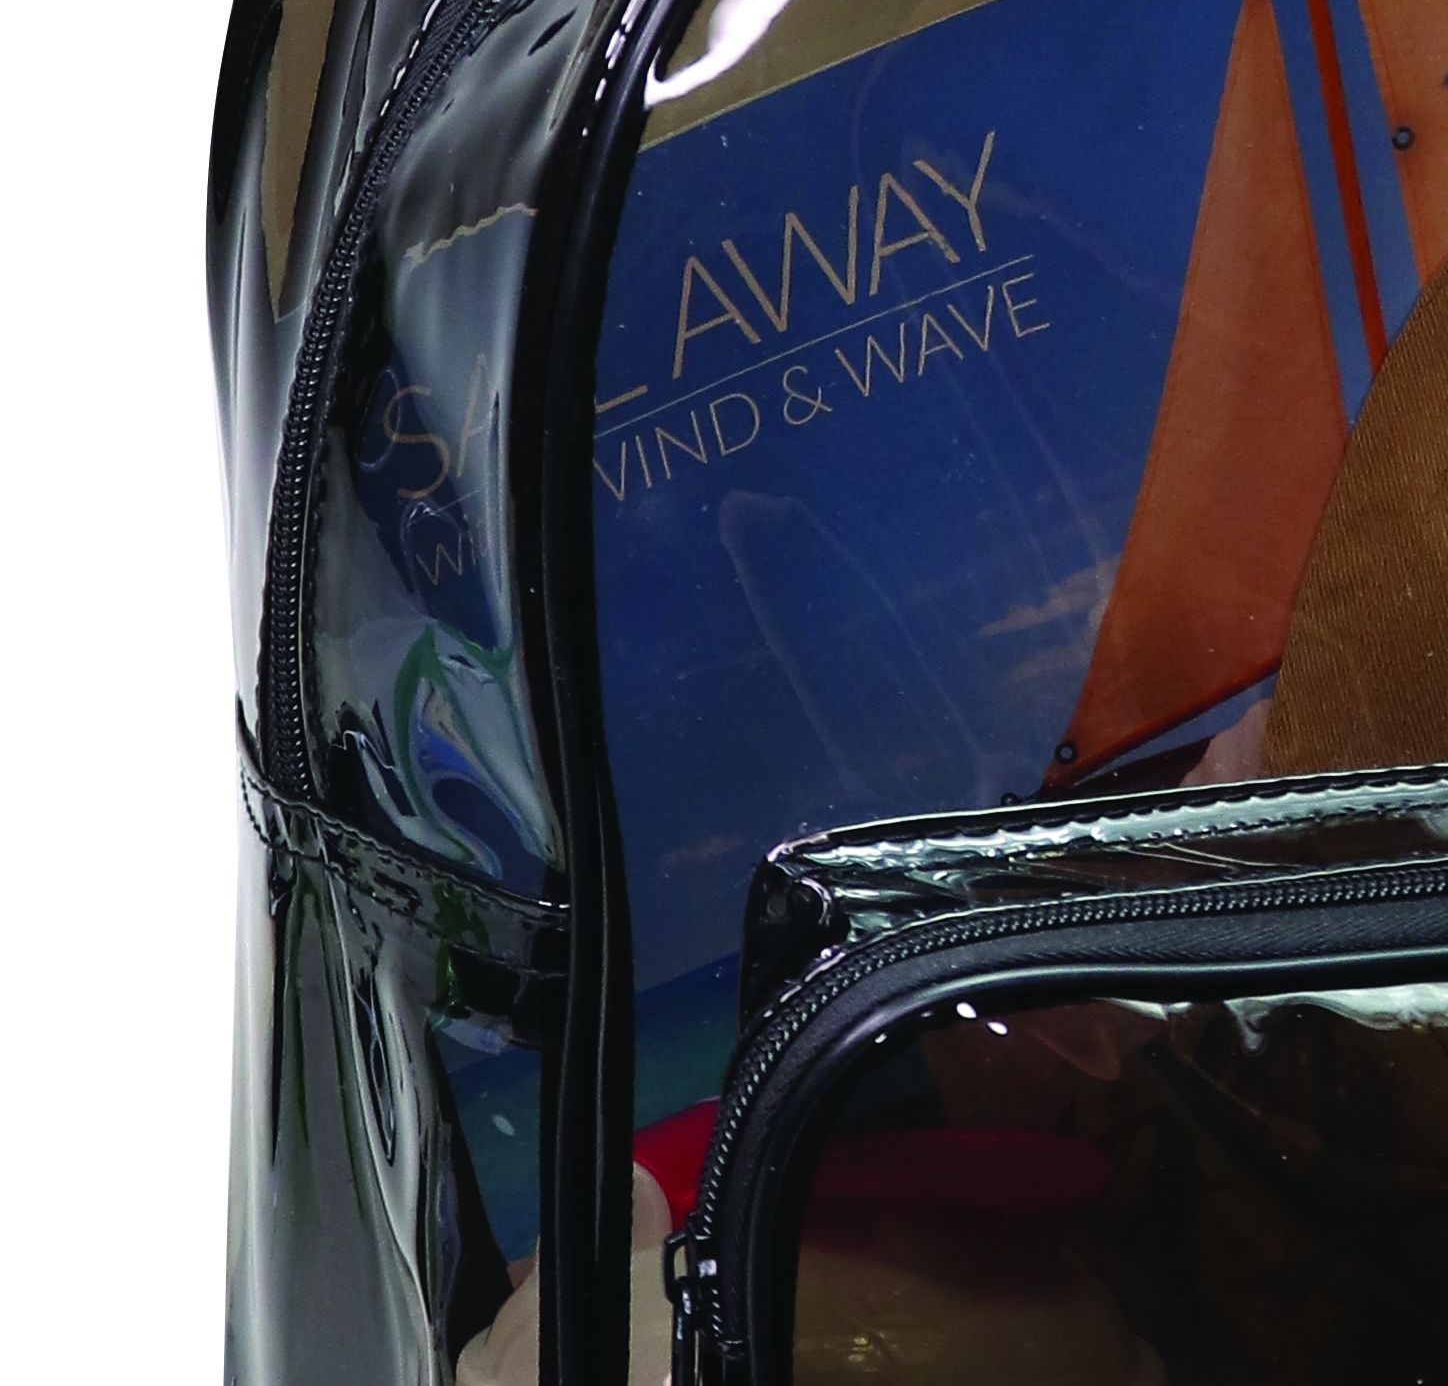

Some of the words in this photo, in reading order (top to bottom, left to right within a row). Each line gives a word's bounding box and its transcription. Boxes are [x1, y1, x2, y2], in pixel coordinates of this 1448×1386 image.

[671, 130, 996, 379] AWAY
[782, 365, 833, 426] &
[834, 272, 1051, 398] WAVE
